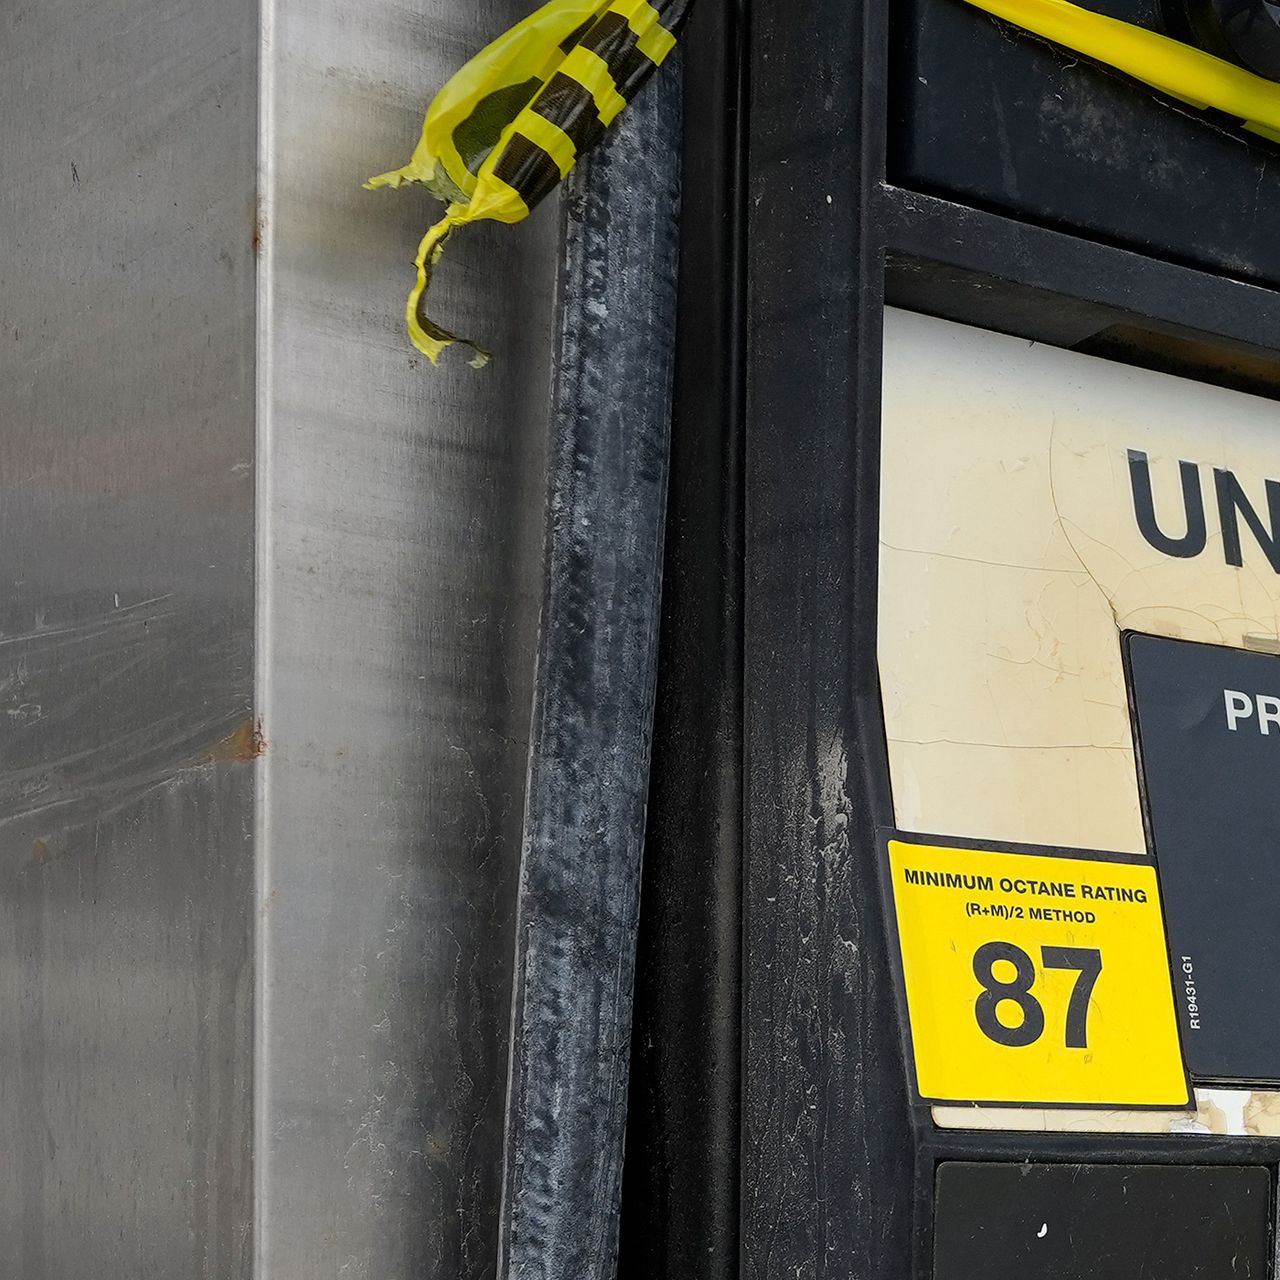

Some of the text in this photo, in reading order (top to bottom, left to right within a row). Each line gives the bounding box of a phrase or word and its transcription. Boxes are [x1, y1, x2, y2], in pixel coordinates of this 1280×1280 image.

[904, 868, 1147, 903] MINIMUM OCTANE RATING
[965, 902, 1096, 924] (R+M)/2 METHOD
[972, 941, 1102, 1049] 87
[1182, 955, 1200, 1030] R19431-G1
